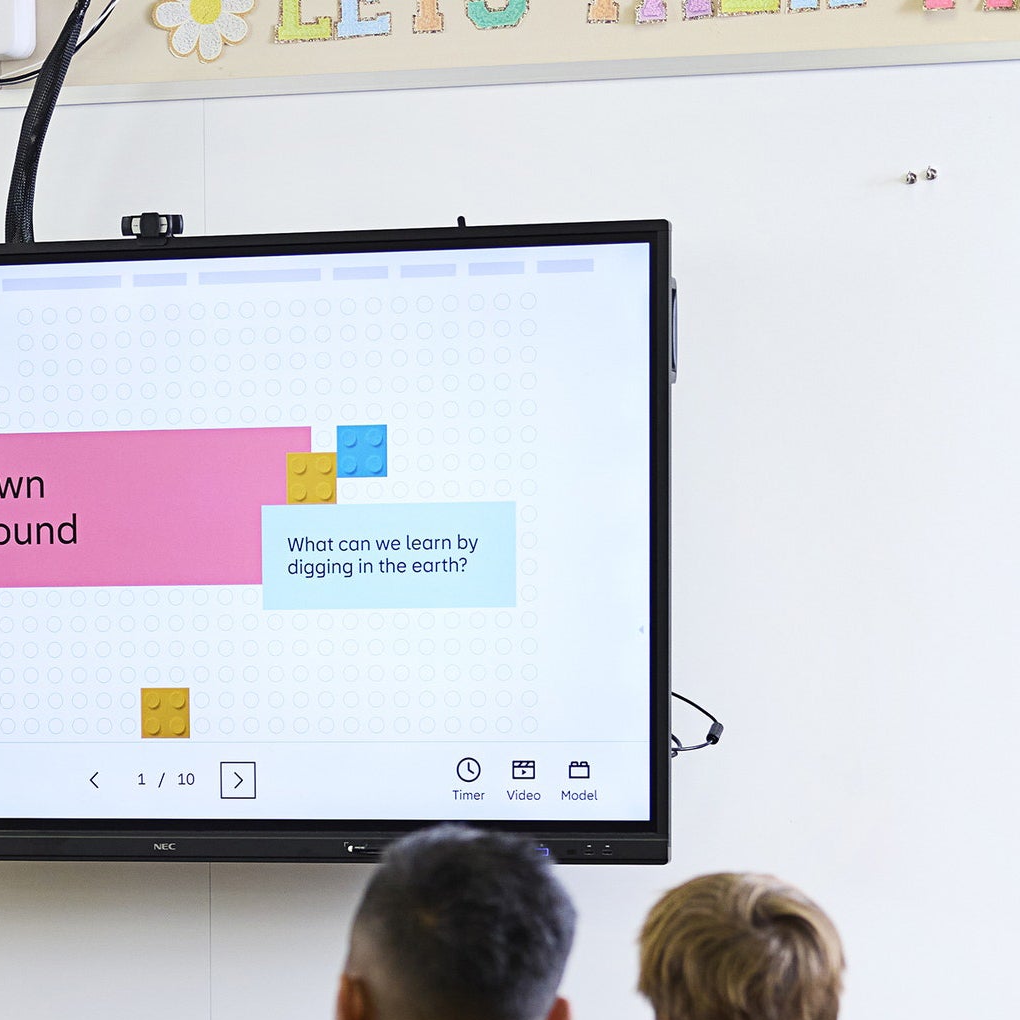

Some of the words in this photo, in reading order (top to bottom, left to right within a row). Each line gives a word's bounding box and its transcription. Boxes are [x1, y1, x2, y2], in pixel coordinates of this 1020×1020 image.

[287, 536, 334, 552] What
[338, 539, 371, 551] can
[375, 538, 401, 551] we
[406, 535, 452, 550] learn
[457, 534, 479, 554] by
[287, 559, 353, 578] digging
[358, 558, 374, 573] in
[379, 558, 407, 573] the
[411, 557, 469, 573] earth?
[137, 773, 146, 787] 1
[177, 772, 196, 787] 10
[452, 789, 486, 801] Timer
[506, 789, 542, 801] Video
[561, 789, 598, 801] Model
[153, 843, 176, 851] NEC
